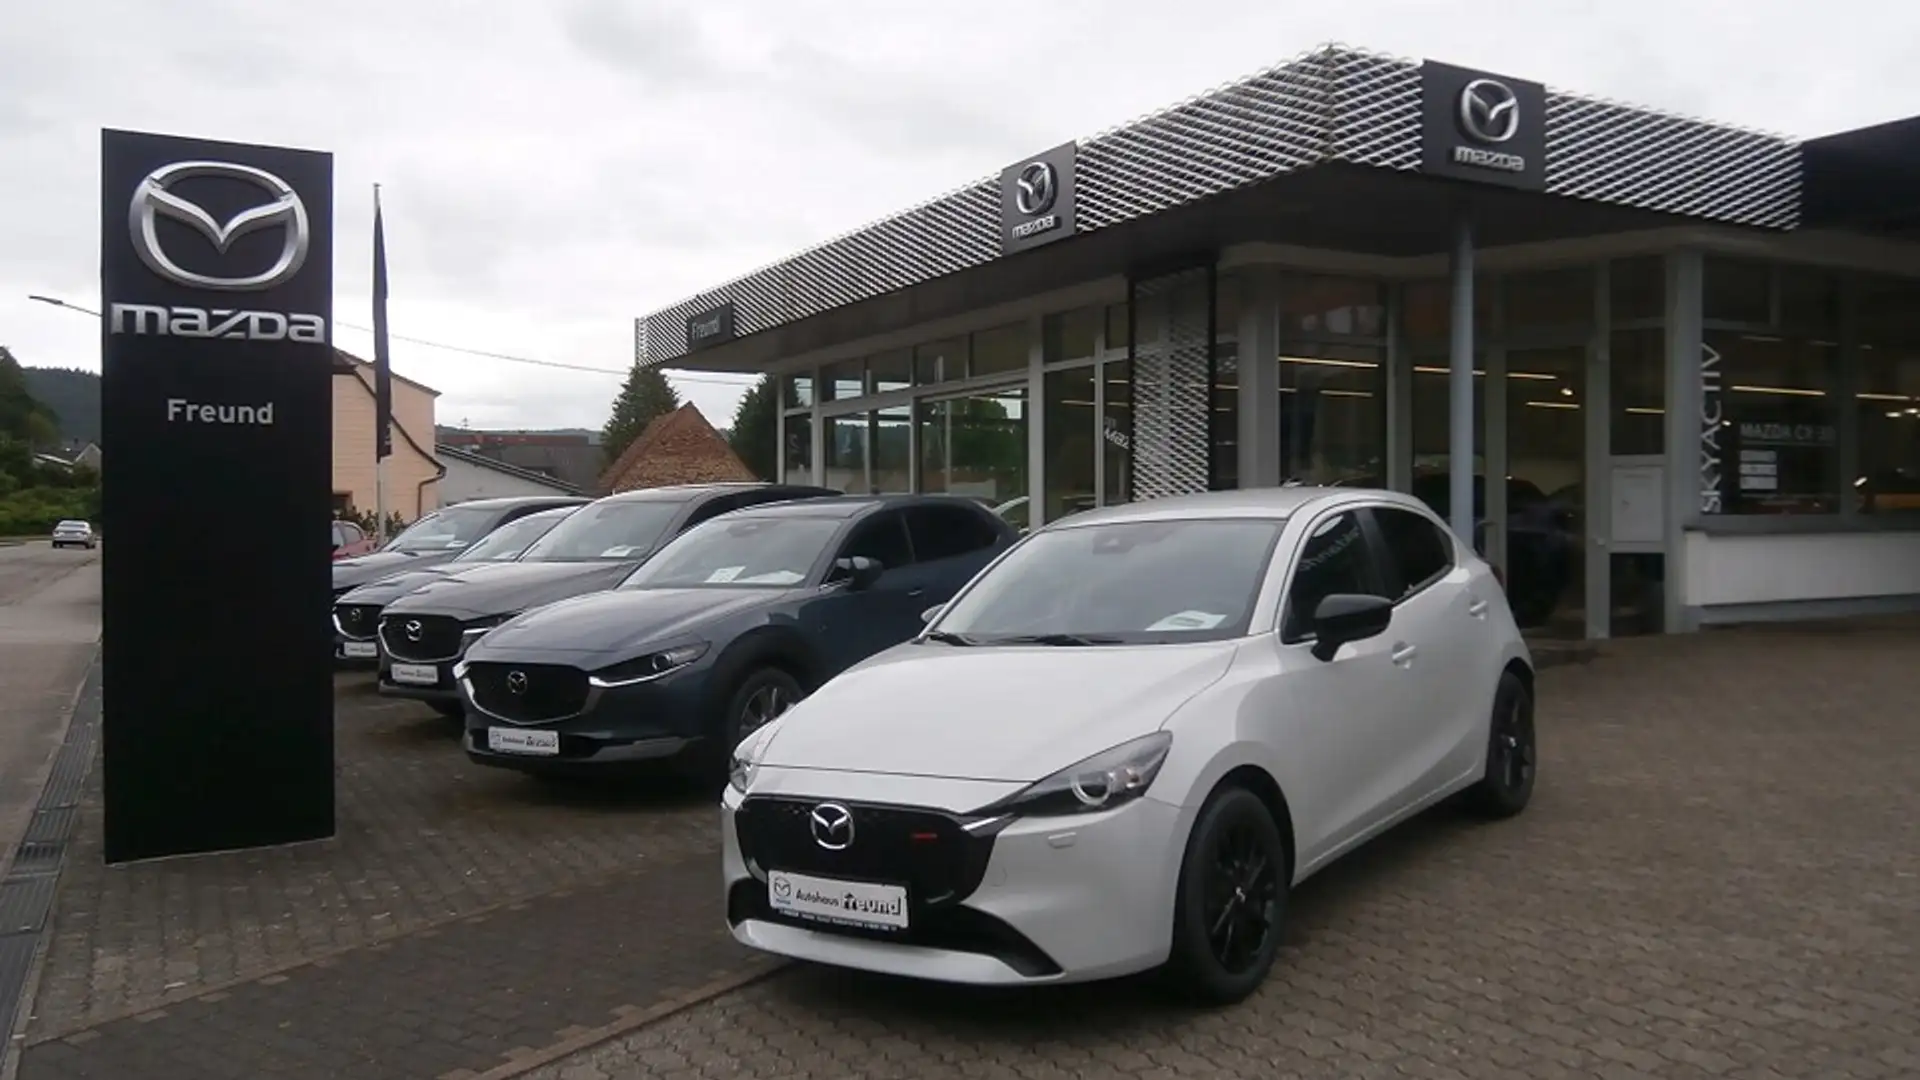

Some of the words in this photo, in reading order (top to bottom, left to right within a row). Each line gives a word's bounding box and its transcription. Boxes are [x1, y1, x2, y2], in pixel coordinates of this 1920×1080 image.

[1454, 146, 1525, 171] mazda
[110, 302, 326, 343] mazda
[167, 398, 274, 424] Freund
[1700, 342, 1722, 513] SKYACTIV
[795, 888, 840, 907] Autohaus
